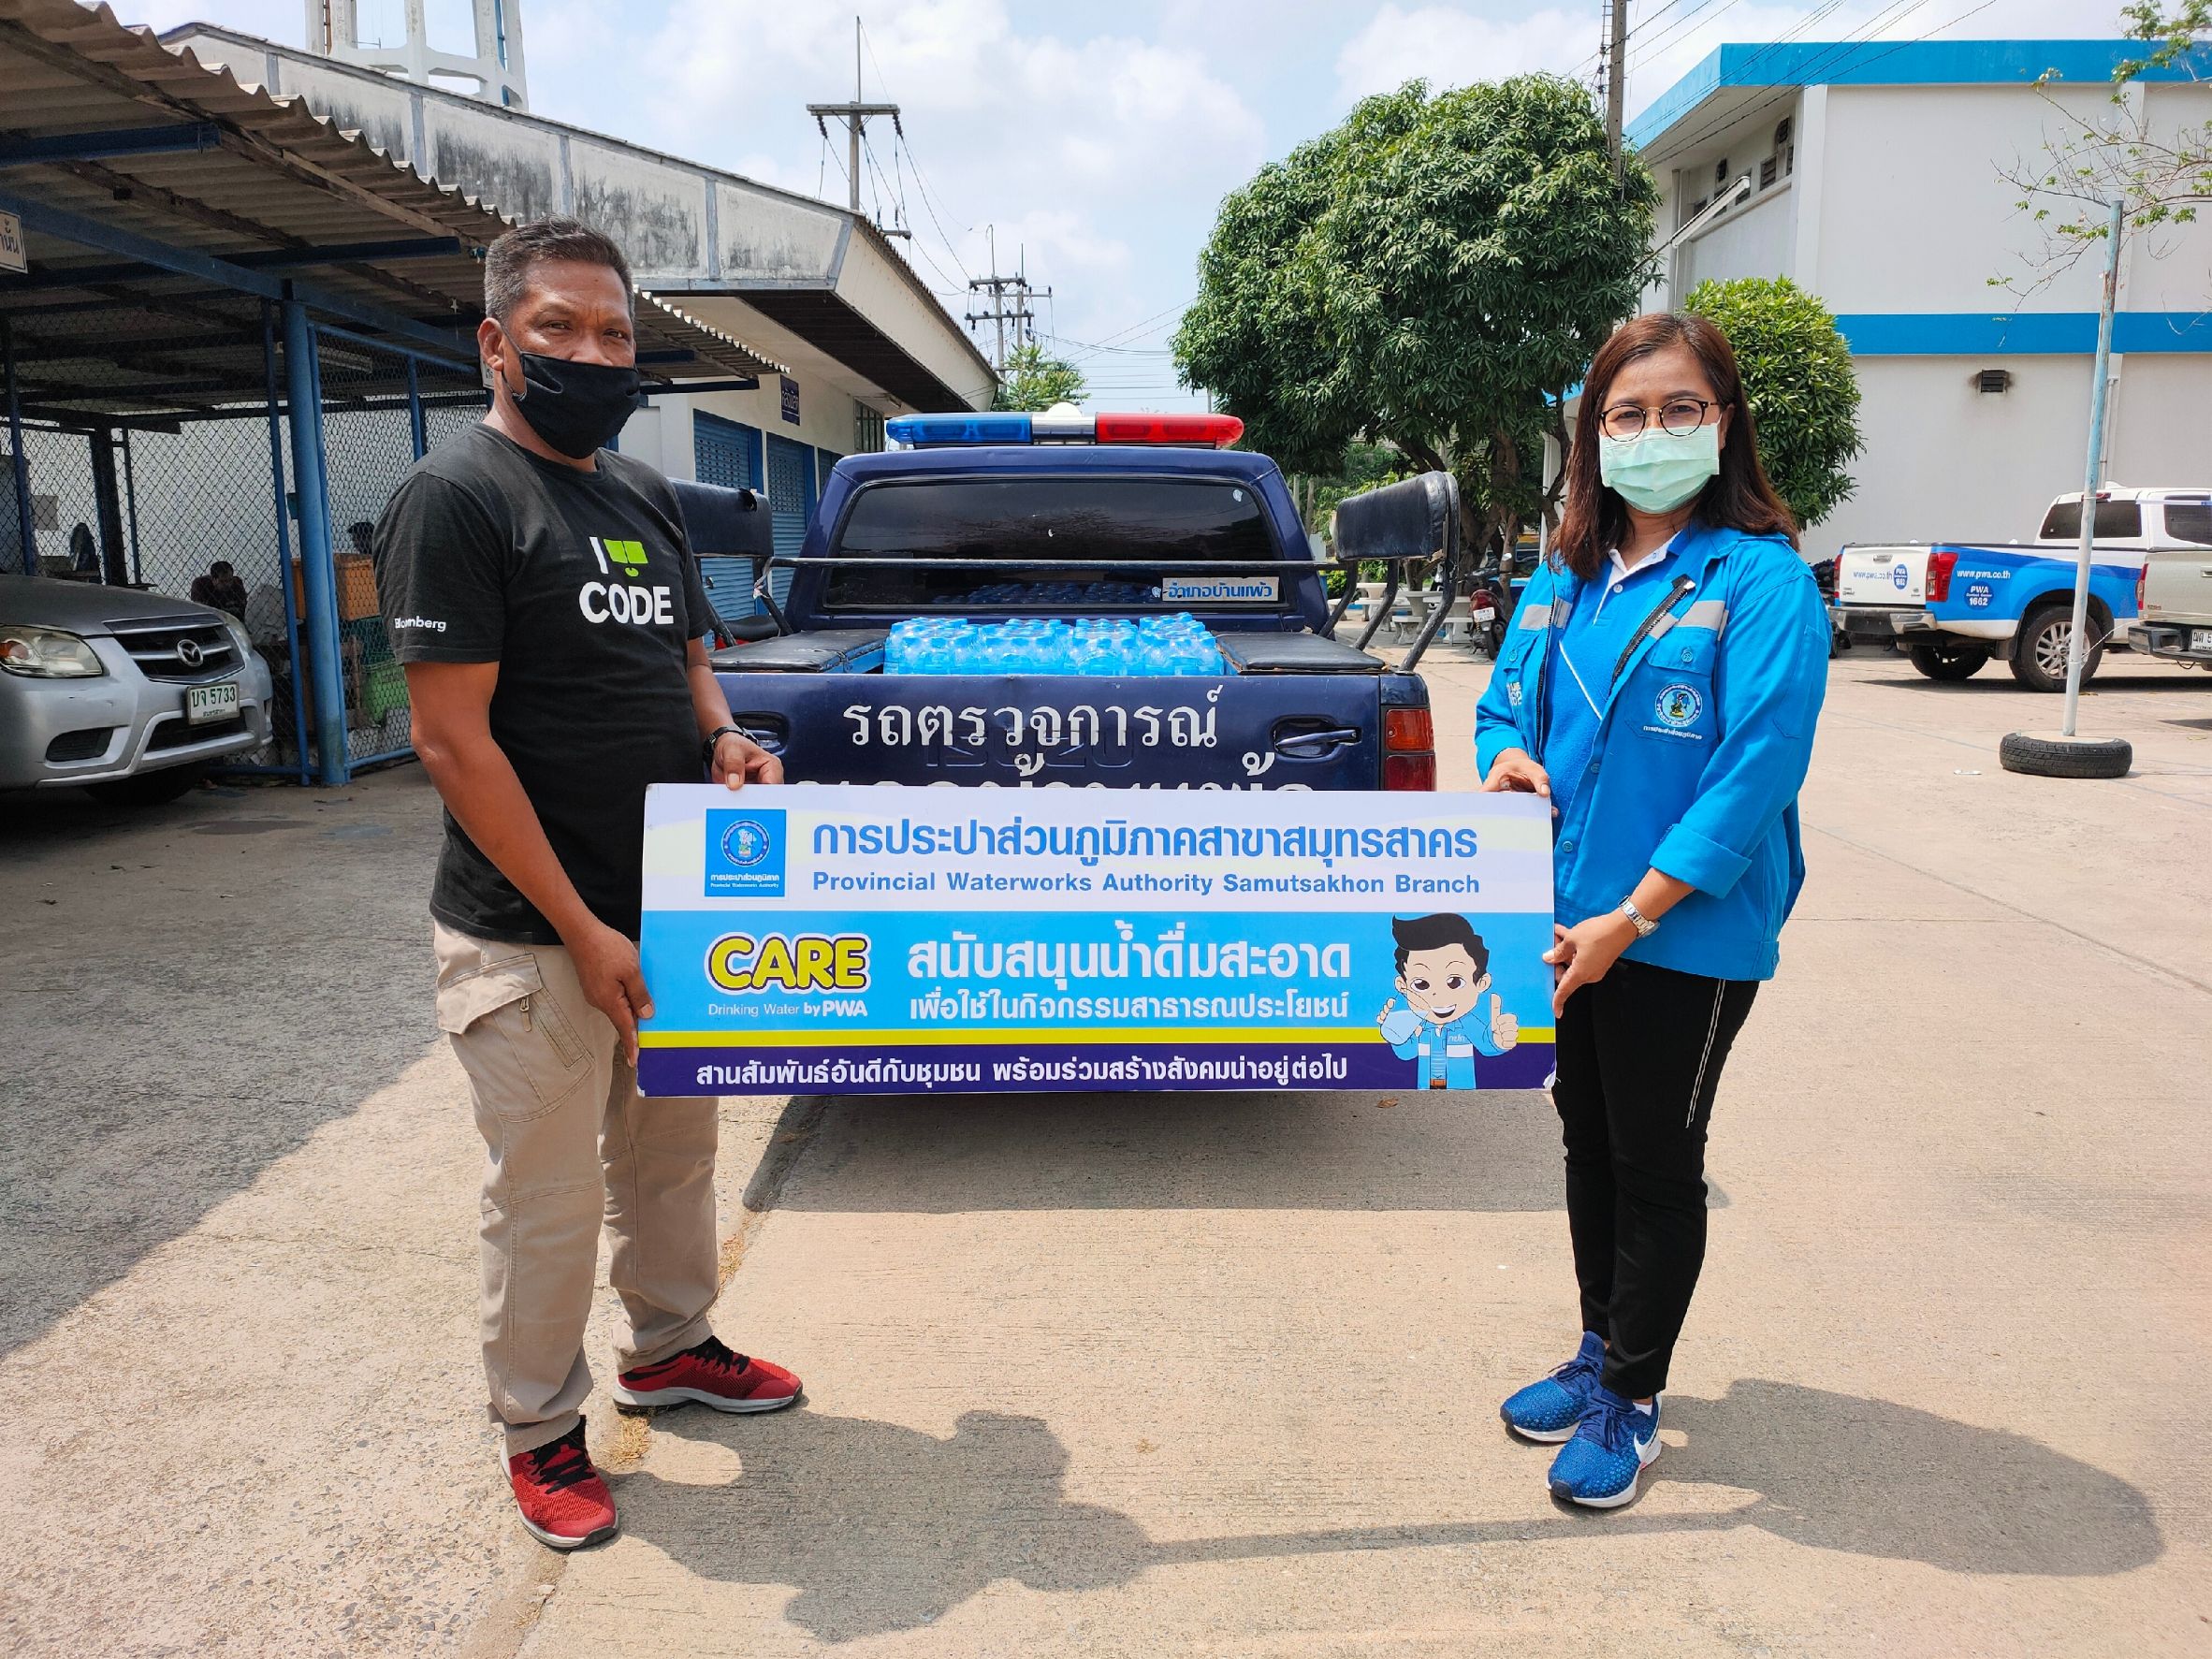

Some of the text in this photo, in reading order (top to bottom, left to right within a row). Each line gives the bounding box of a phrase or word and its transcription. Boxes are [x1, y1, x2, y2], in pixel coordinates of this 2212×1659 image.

[589, 536, 609, 575] I
[1957, 570, 2011, 579] www.pwa.co.th
[1970, 585, 1989, 593] PWA
[579, 581, 675, 625] CODE
[210, 686, 236, 704] 5733
[843, 684, 1223, 747] รถตรวจการณ์
[813, 816, 1478, 867] การประปาส่วนภูมิภาคสาขาสมุทรสาคร
[813, 871, 1480, 895] Provincial Waterworks Authority Samutsakhon Branch
[706, 934, 869, 993] CARE
[907, 920, 1350, 991] สนับสนุนน้ำดื่มสะอาด
[708, 999, 868, 1017] Drinking Water by PWA
[910, 986, 1349, 1019] เพื่อใช้ในกิจกรรมสาธารณประโยชน์
[696, 1053, 1347, 1088] สานสัมพันธ์อันดีกับชุมชน พร้อมร่วมสร้างสังคมน่าอยู่ต่อไป
